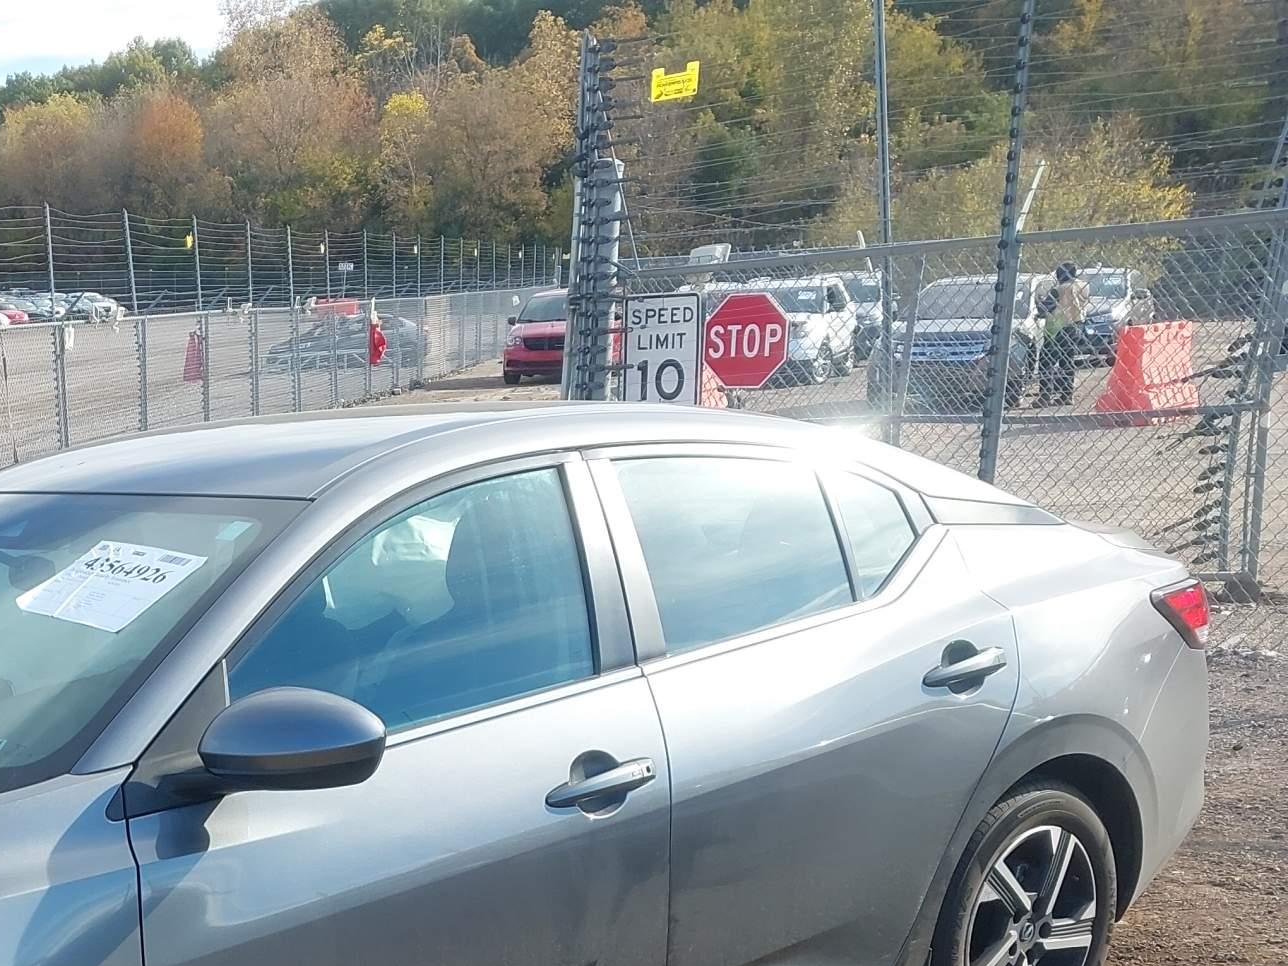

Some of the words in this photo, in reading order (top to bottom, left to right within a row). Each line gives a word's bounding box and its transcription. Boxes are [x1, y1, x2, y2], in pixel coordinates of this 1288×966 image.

[631, 306, 694, 325] SPEED
[637, 332, 687, 350] LIMIT
[708, 323, 783, 359] STOP
[636, 358, 685, 401] 10
[84, 556, 175, 584] 43564926
